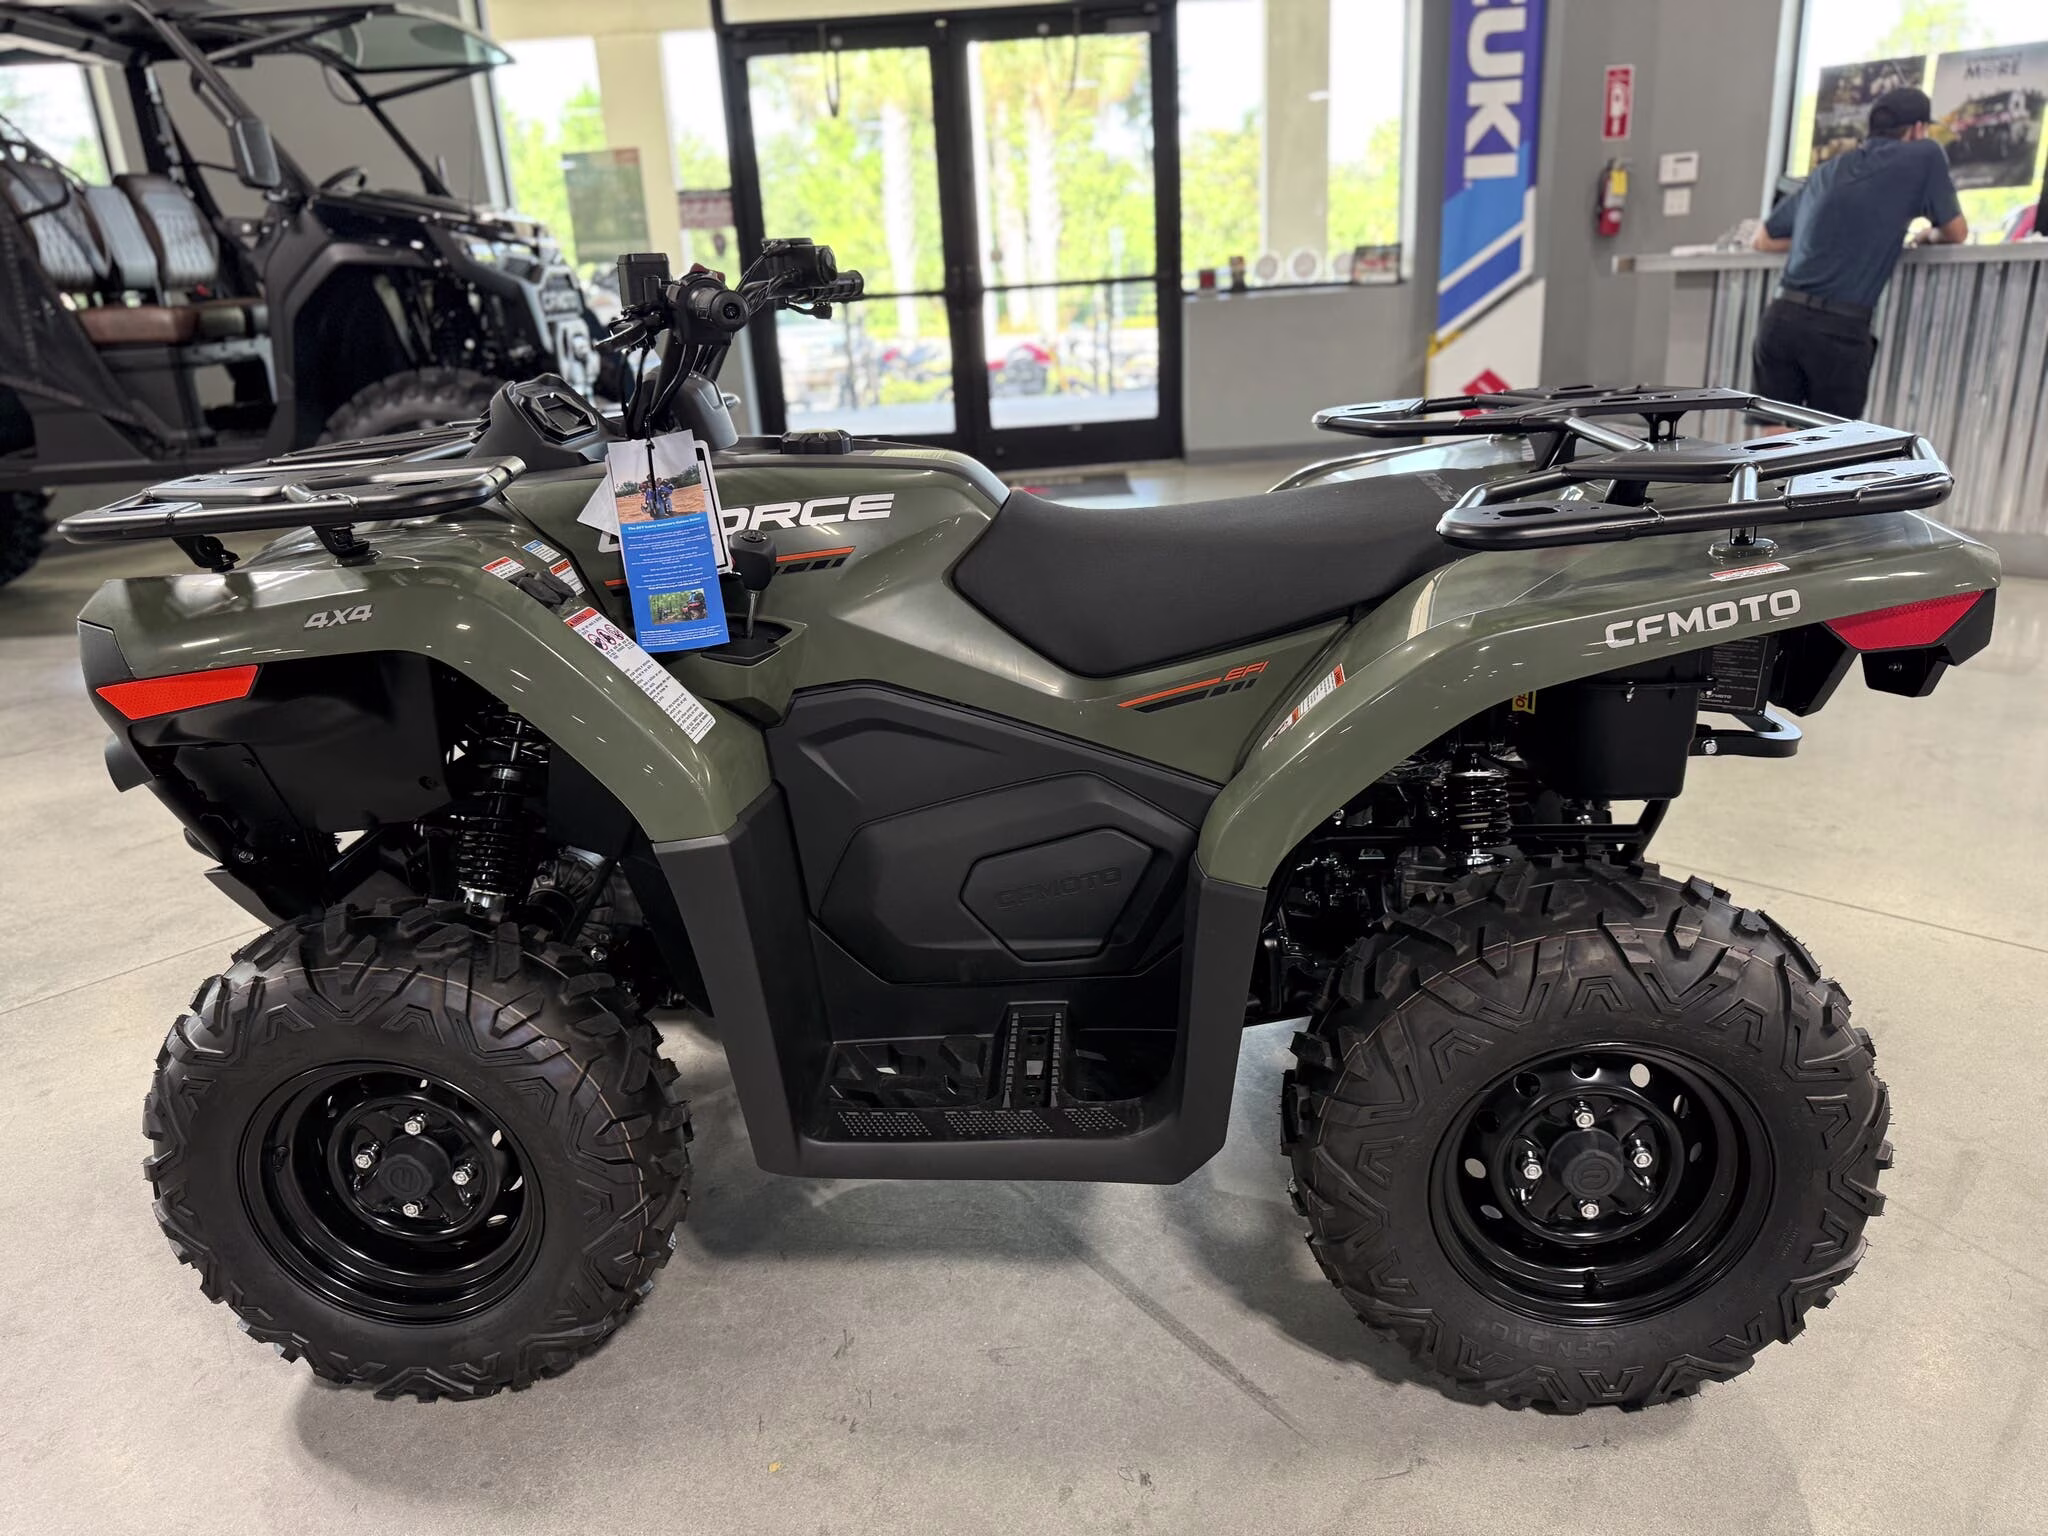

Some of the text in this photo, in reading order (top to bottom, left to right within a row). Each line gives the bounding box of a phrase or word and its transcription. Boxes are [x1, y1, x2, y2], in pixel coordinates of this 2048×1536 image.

[1464, 0, 1527, 179] UKI
[1605, 588, 1801, 649] CFMOTO
[1224, 660, 1270, 681] EFI
[994, 866, 1122, 911] CFMOTO
